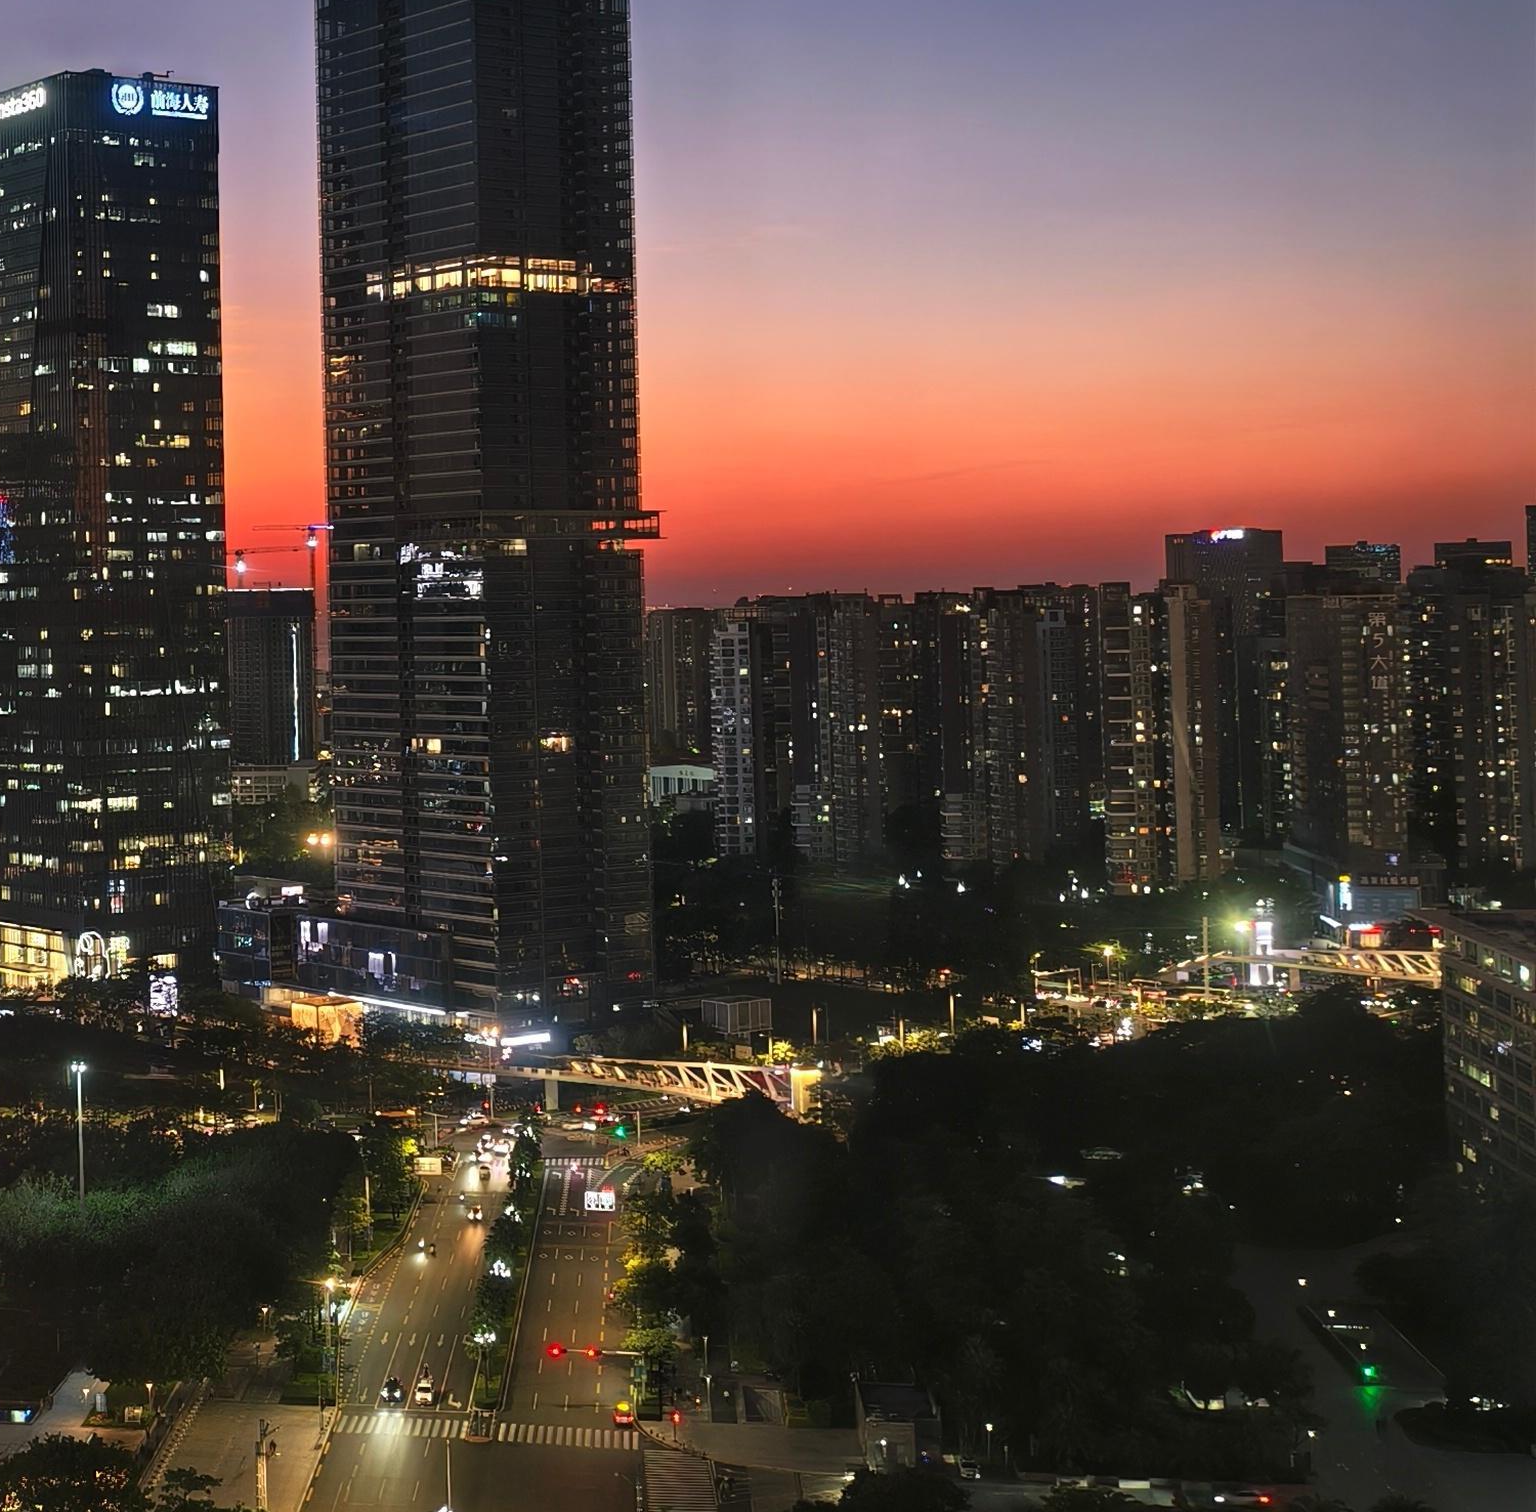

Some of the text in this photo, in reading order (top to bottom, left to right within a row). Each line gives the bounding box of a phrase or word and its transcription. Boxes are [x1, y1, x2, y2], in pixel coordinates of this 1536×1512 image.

[150, 89, 209, 114] 前海人寿
[1367, 612, 1389, 690] 第5大道
